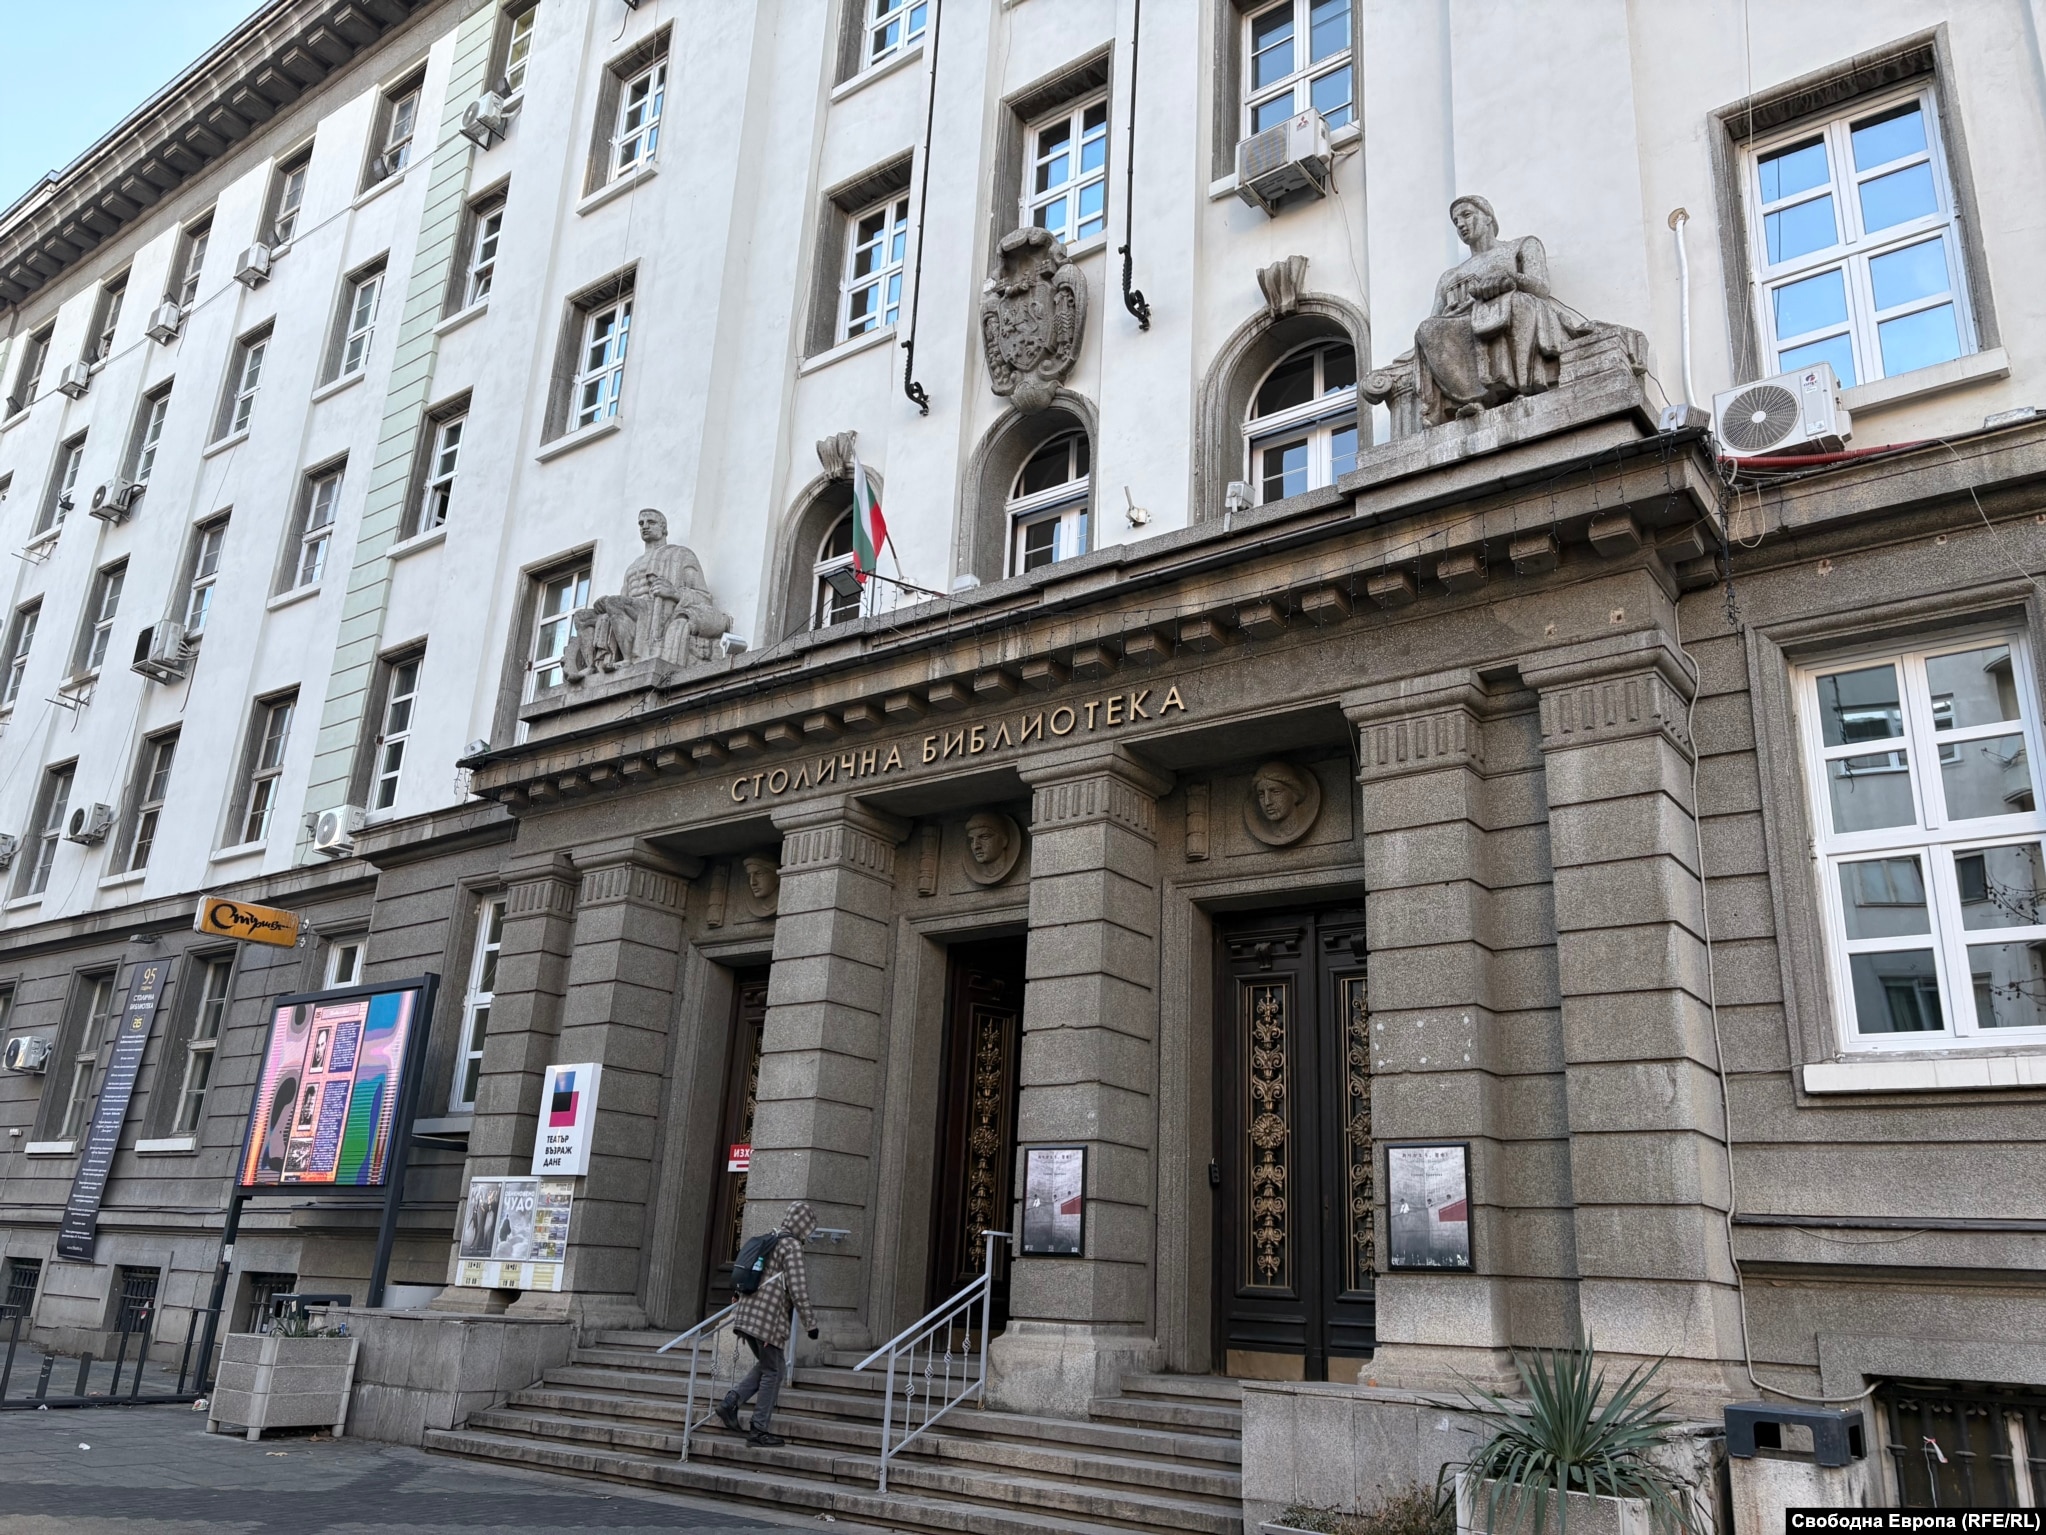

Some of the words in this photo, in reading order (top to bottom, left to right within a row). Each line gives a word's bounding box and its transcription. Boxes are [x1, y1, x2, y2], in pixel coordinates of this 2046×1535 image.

[731, 743, 903, 802] СТОЛИЧНА
[922, 686, 1187, 763] БИБЛИОТЕКА
[142, 967, 158, 985] 95
[547, 1135, 569, 1144] ТЕАТЪР
[545, 1146, 572, 1154] ВЪЗРАЖ
[543, 1158, 561, 1167] ДАНЕ
[504, 1197, 534, 1212] ЧУДО
